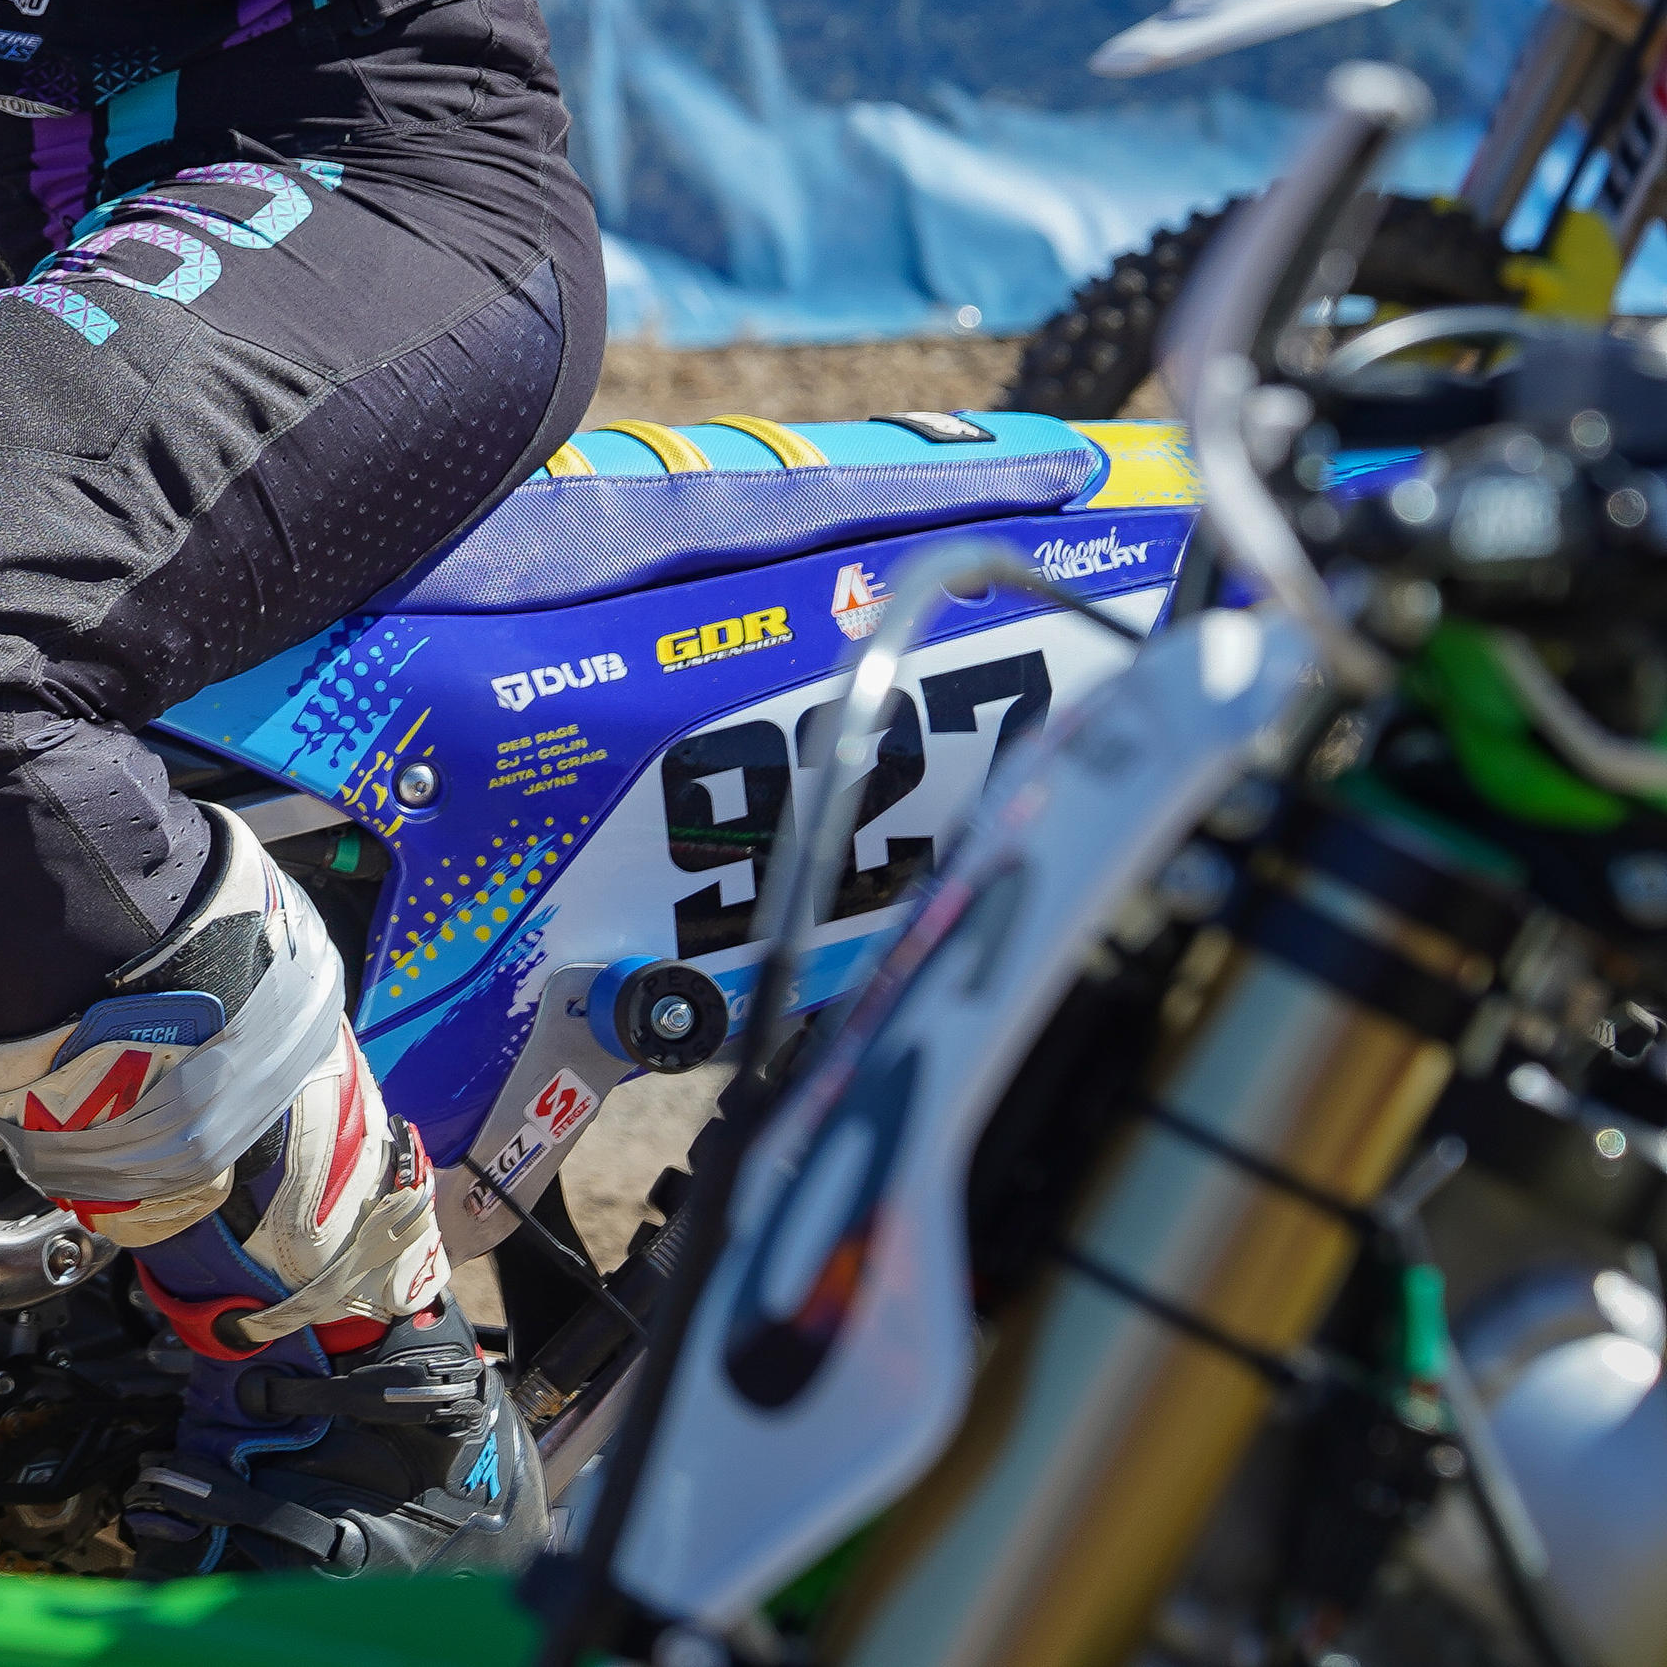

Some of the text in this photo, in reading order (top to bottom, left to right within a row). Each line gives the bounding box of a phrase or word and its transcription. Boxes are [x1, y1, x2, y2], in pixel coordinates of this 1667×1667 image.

[656, 605, 792, 668] GDR
[662, 631, 794, 675] SUSPENSION
[531, 652, 629, 698] DUB
[129, 1026, 179, 1045] TECH
[552, 1094, 593, 1140] STEGZ
